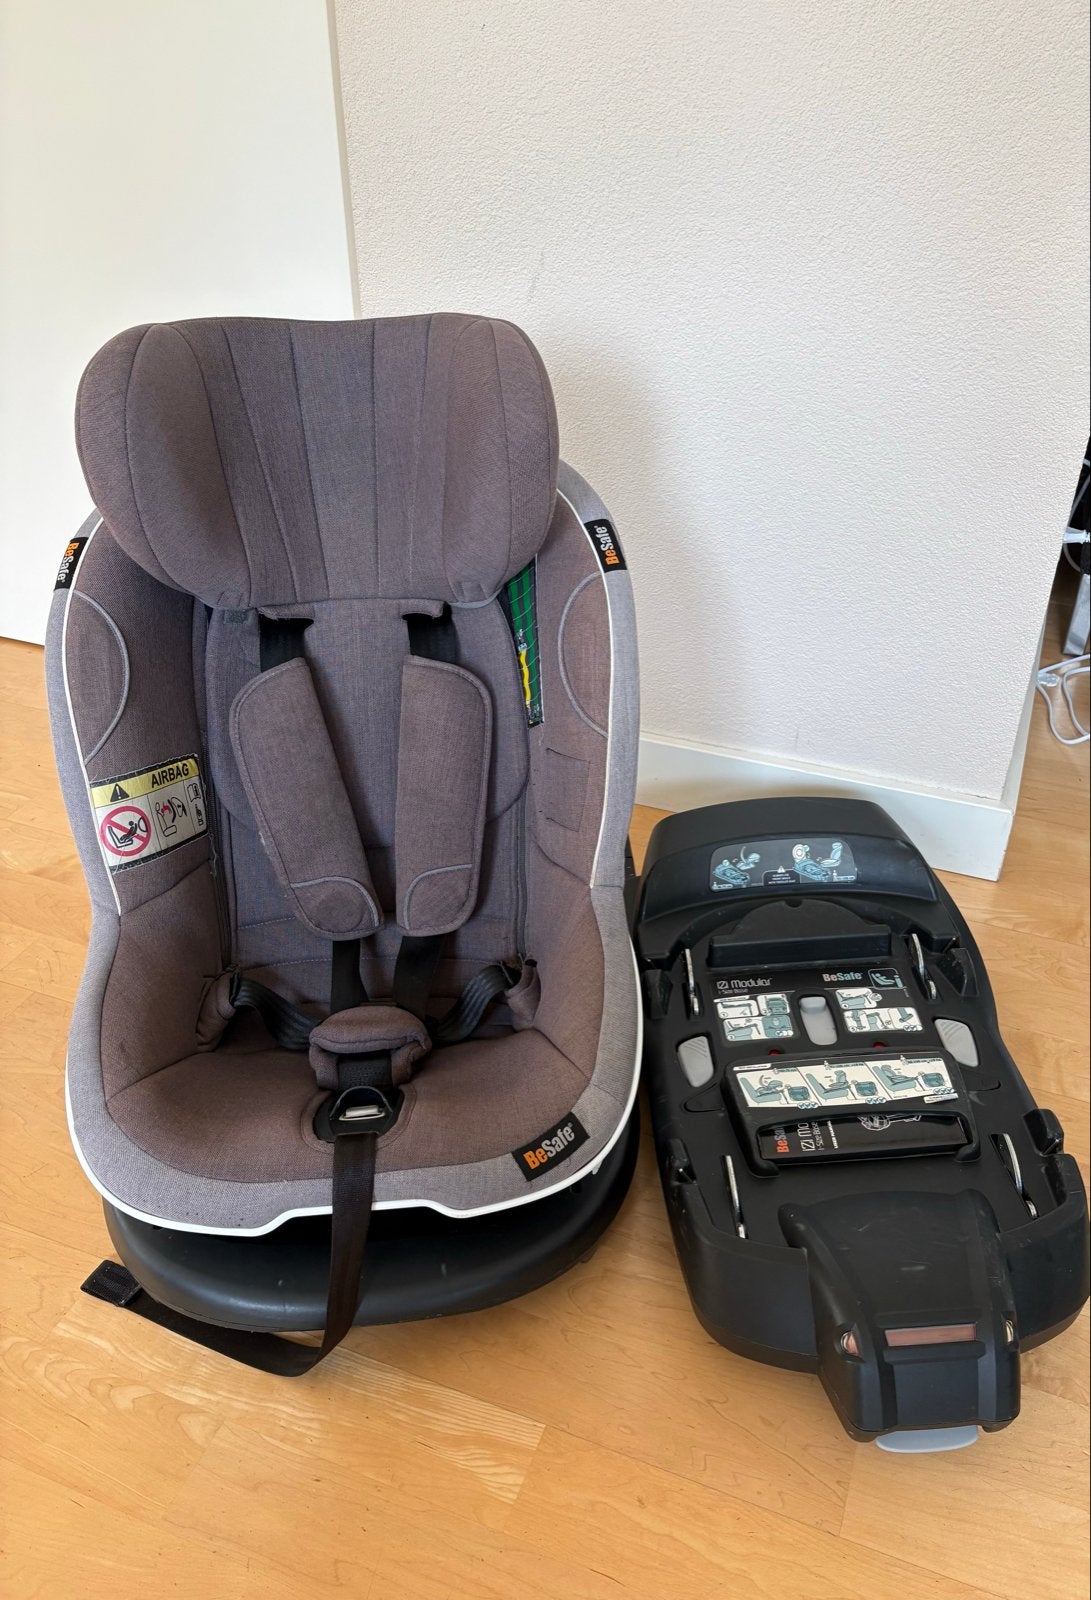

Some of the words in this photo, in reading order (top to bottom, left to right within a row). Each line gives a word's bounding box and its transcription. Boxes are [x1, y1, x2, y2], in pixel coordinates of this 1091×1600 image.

[596, 527, 620, 565] BeSafe
[151, 763, 190, 788] AIRBAG
[822, 972, 863, 982] BeSafe
[523, 1126, 575, 1169] BeSafe
